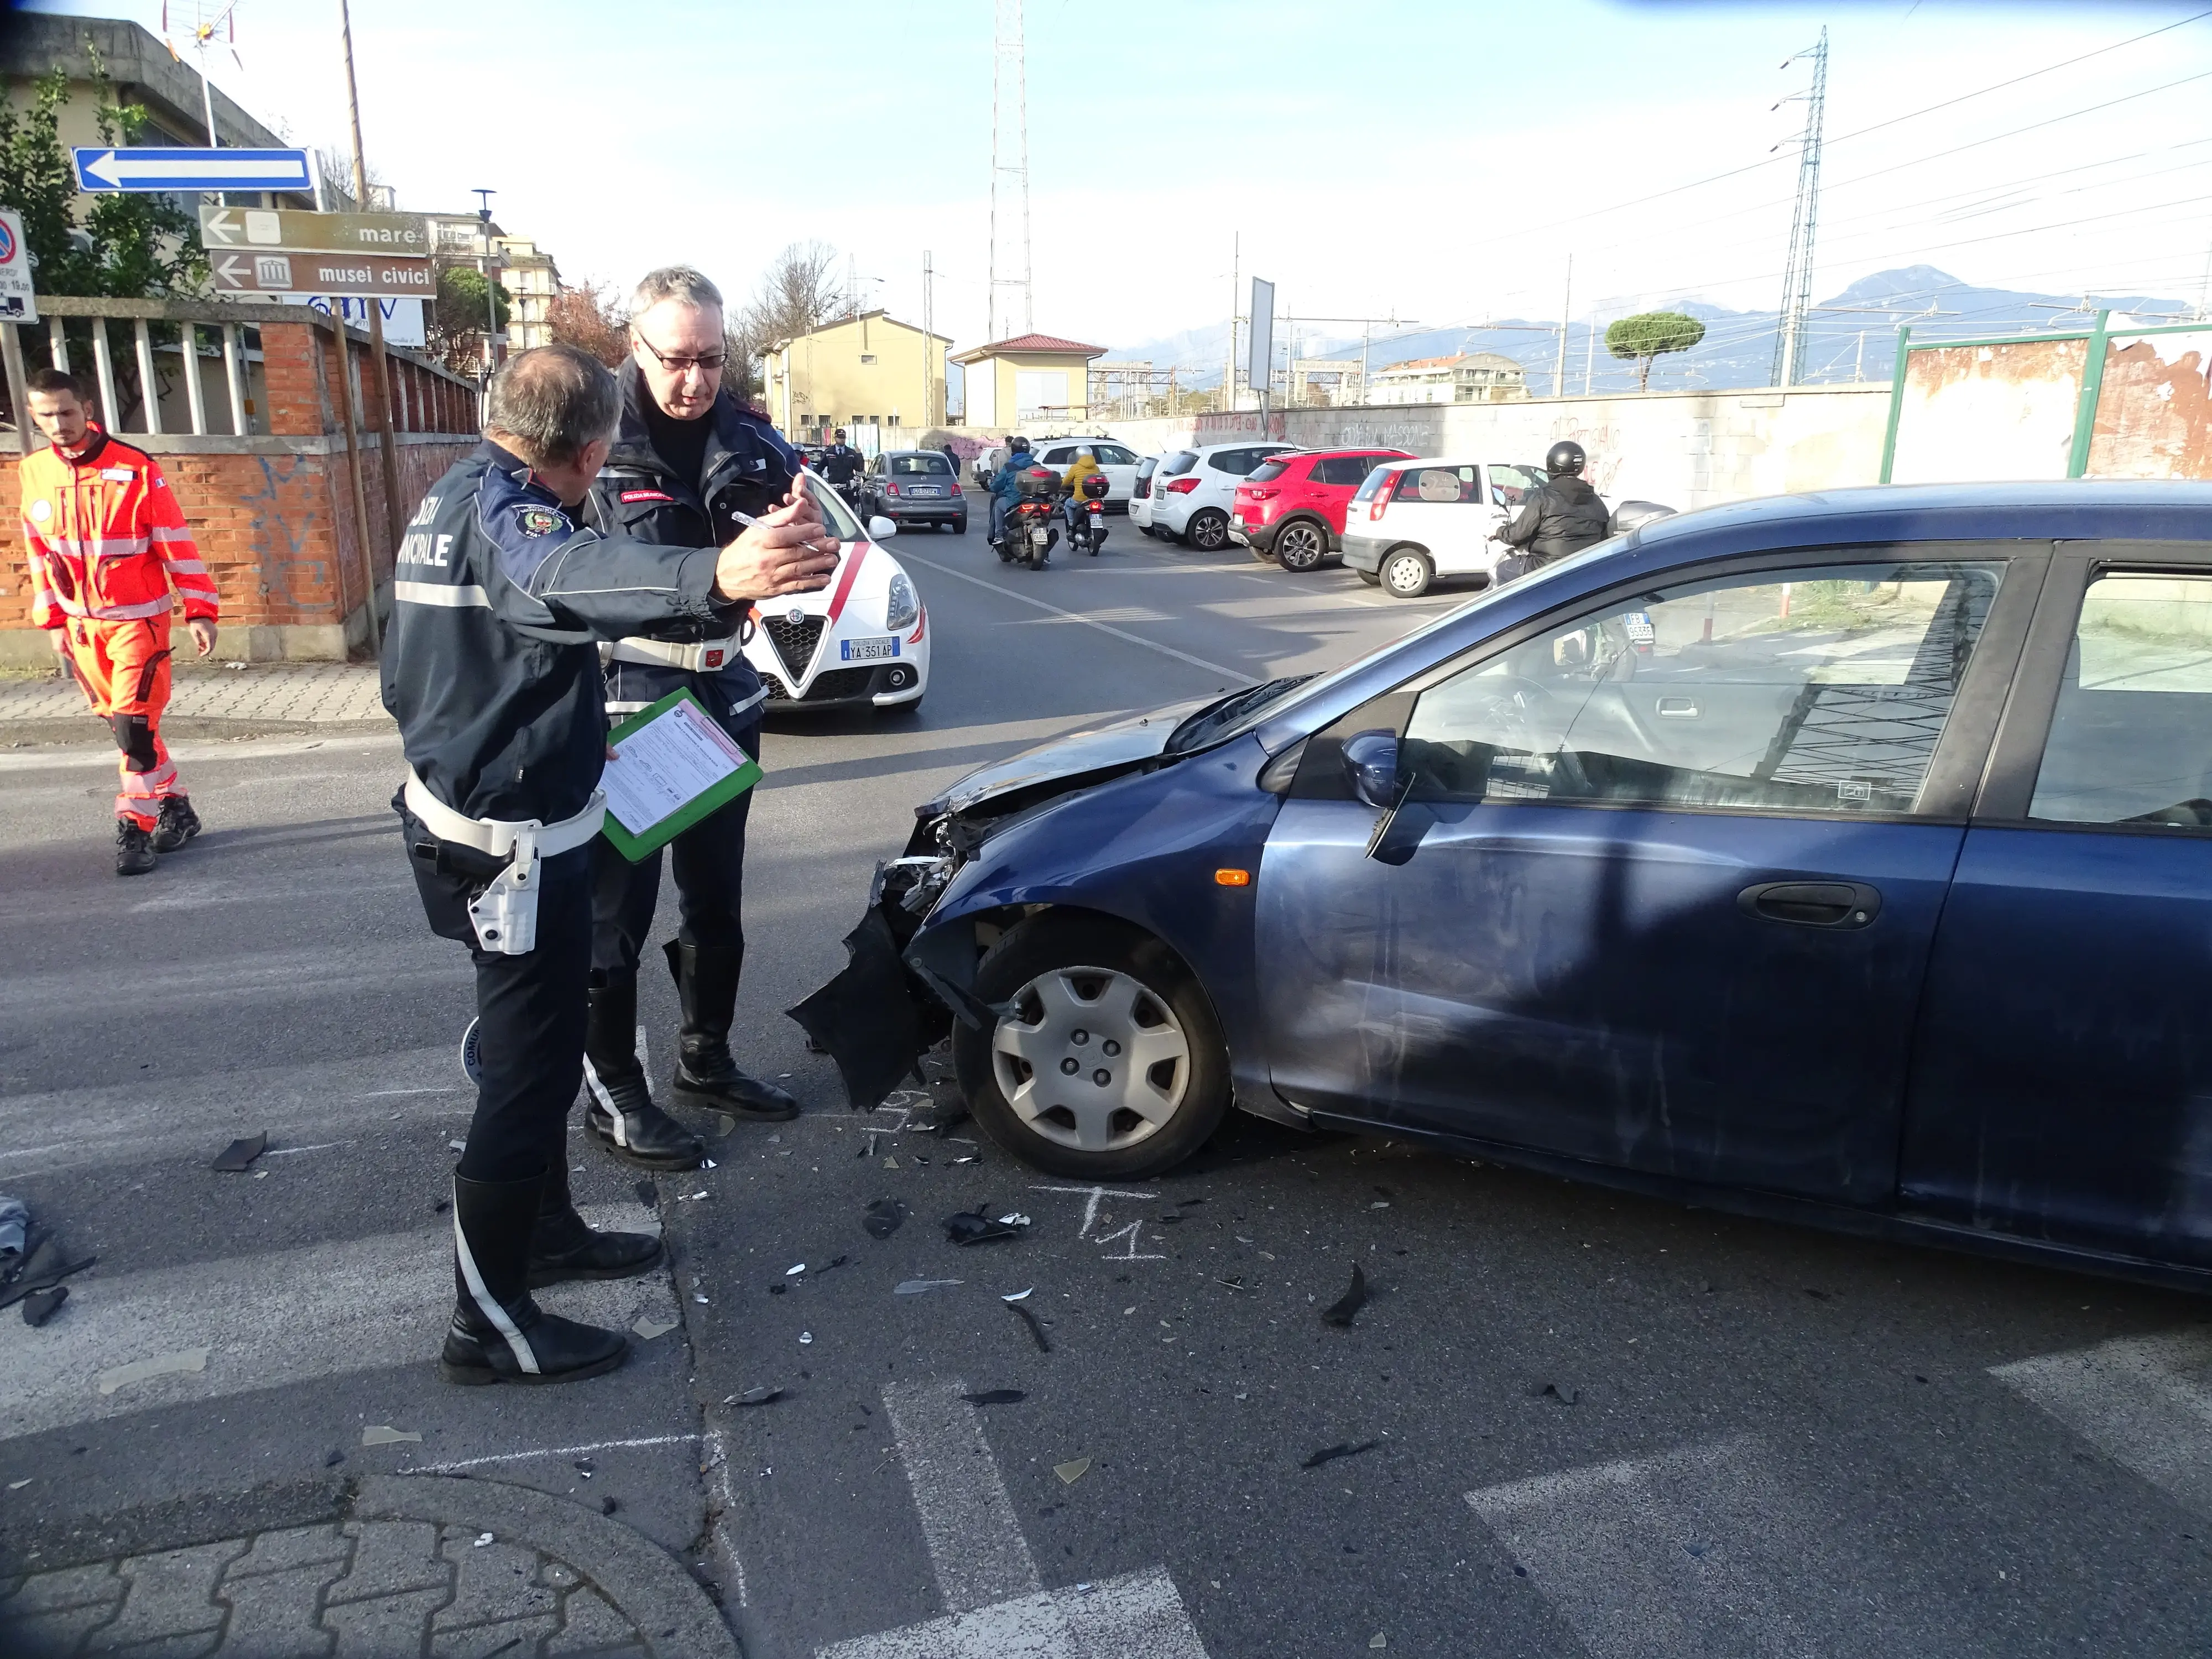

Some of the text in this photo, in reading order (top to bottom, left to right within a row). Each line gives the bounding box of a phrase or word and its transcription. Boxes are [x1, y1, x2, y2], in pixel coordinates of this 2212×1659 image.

[359, 228, 416, 244] mare
[319, 266, 429, 286] musei civici
[1631, 614, 1640, 624] FB
